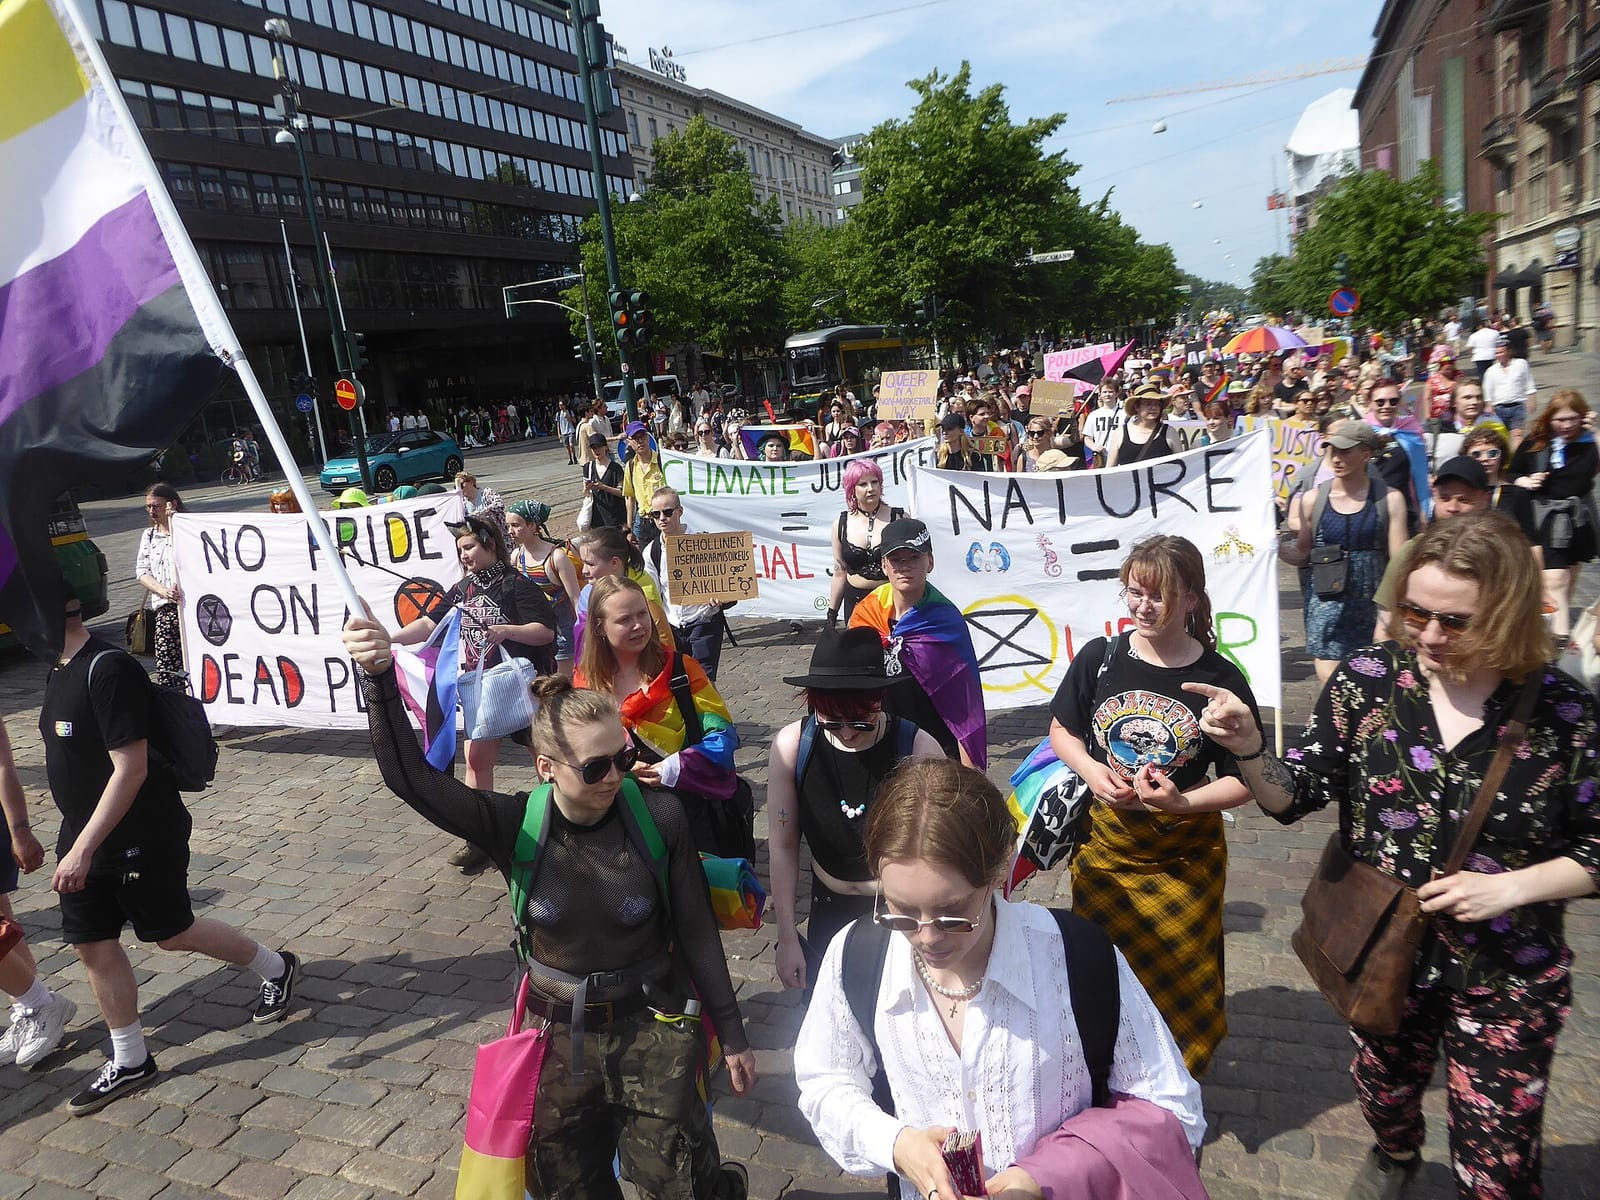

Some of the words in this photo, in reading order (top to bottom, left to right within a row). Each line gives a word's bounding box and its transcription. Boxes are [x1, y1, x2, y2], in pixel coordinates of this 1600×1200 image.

[648, 47, 687, 82] Regus
[885, 371, 928, 388] QUEER
[895, 406, 916, 418] WAY
[662, 460, 799, 497] CLIMATE
[200, 524, 266, 573] NO
[677, 536, 744, 552] KEHOLLINEN
[689, 564, 727, 578] KUULUU
[682, 577, 737, 596] KAIKILLE
[251, 583, 320, 635] ON
[201, 654, 306, 708] DEAD
